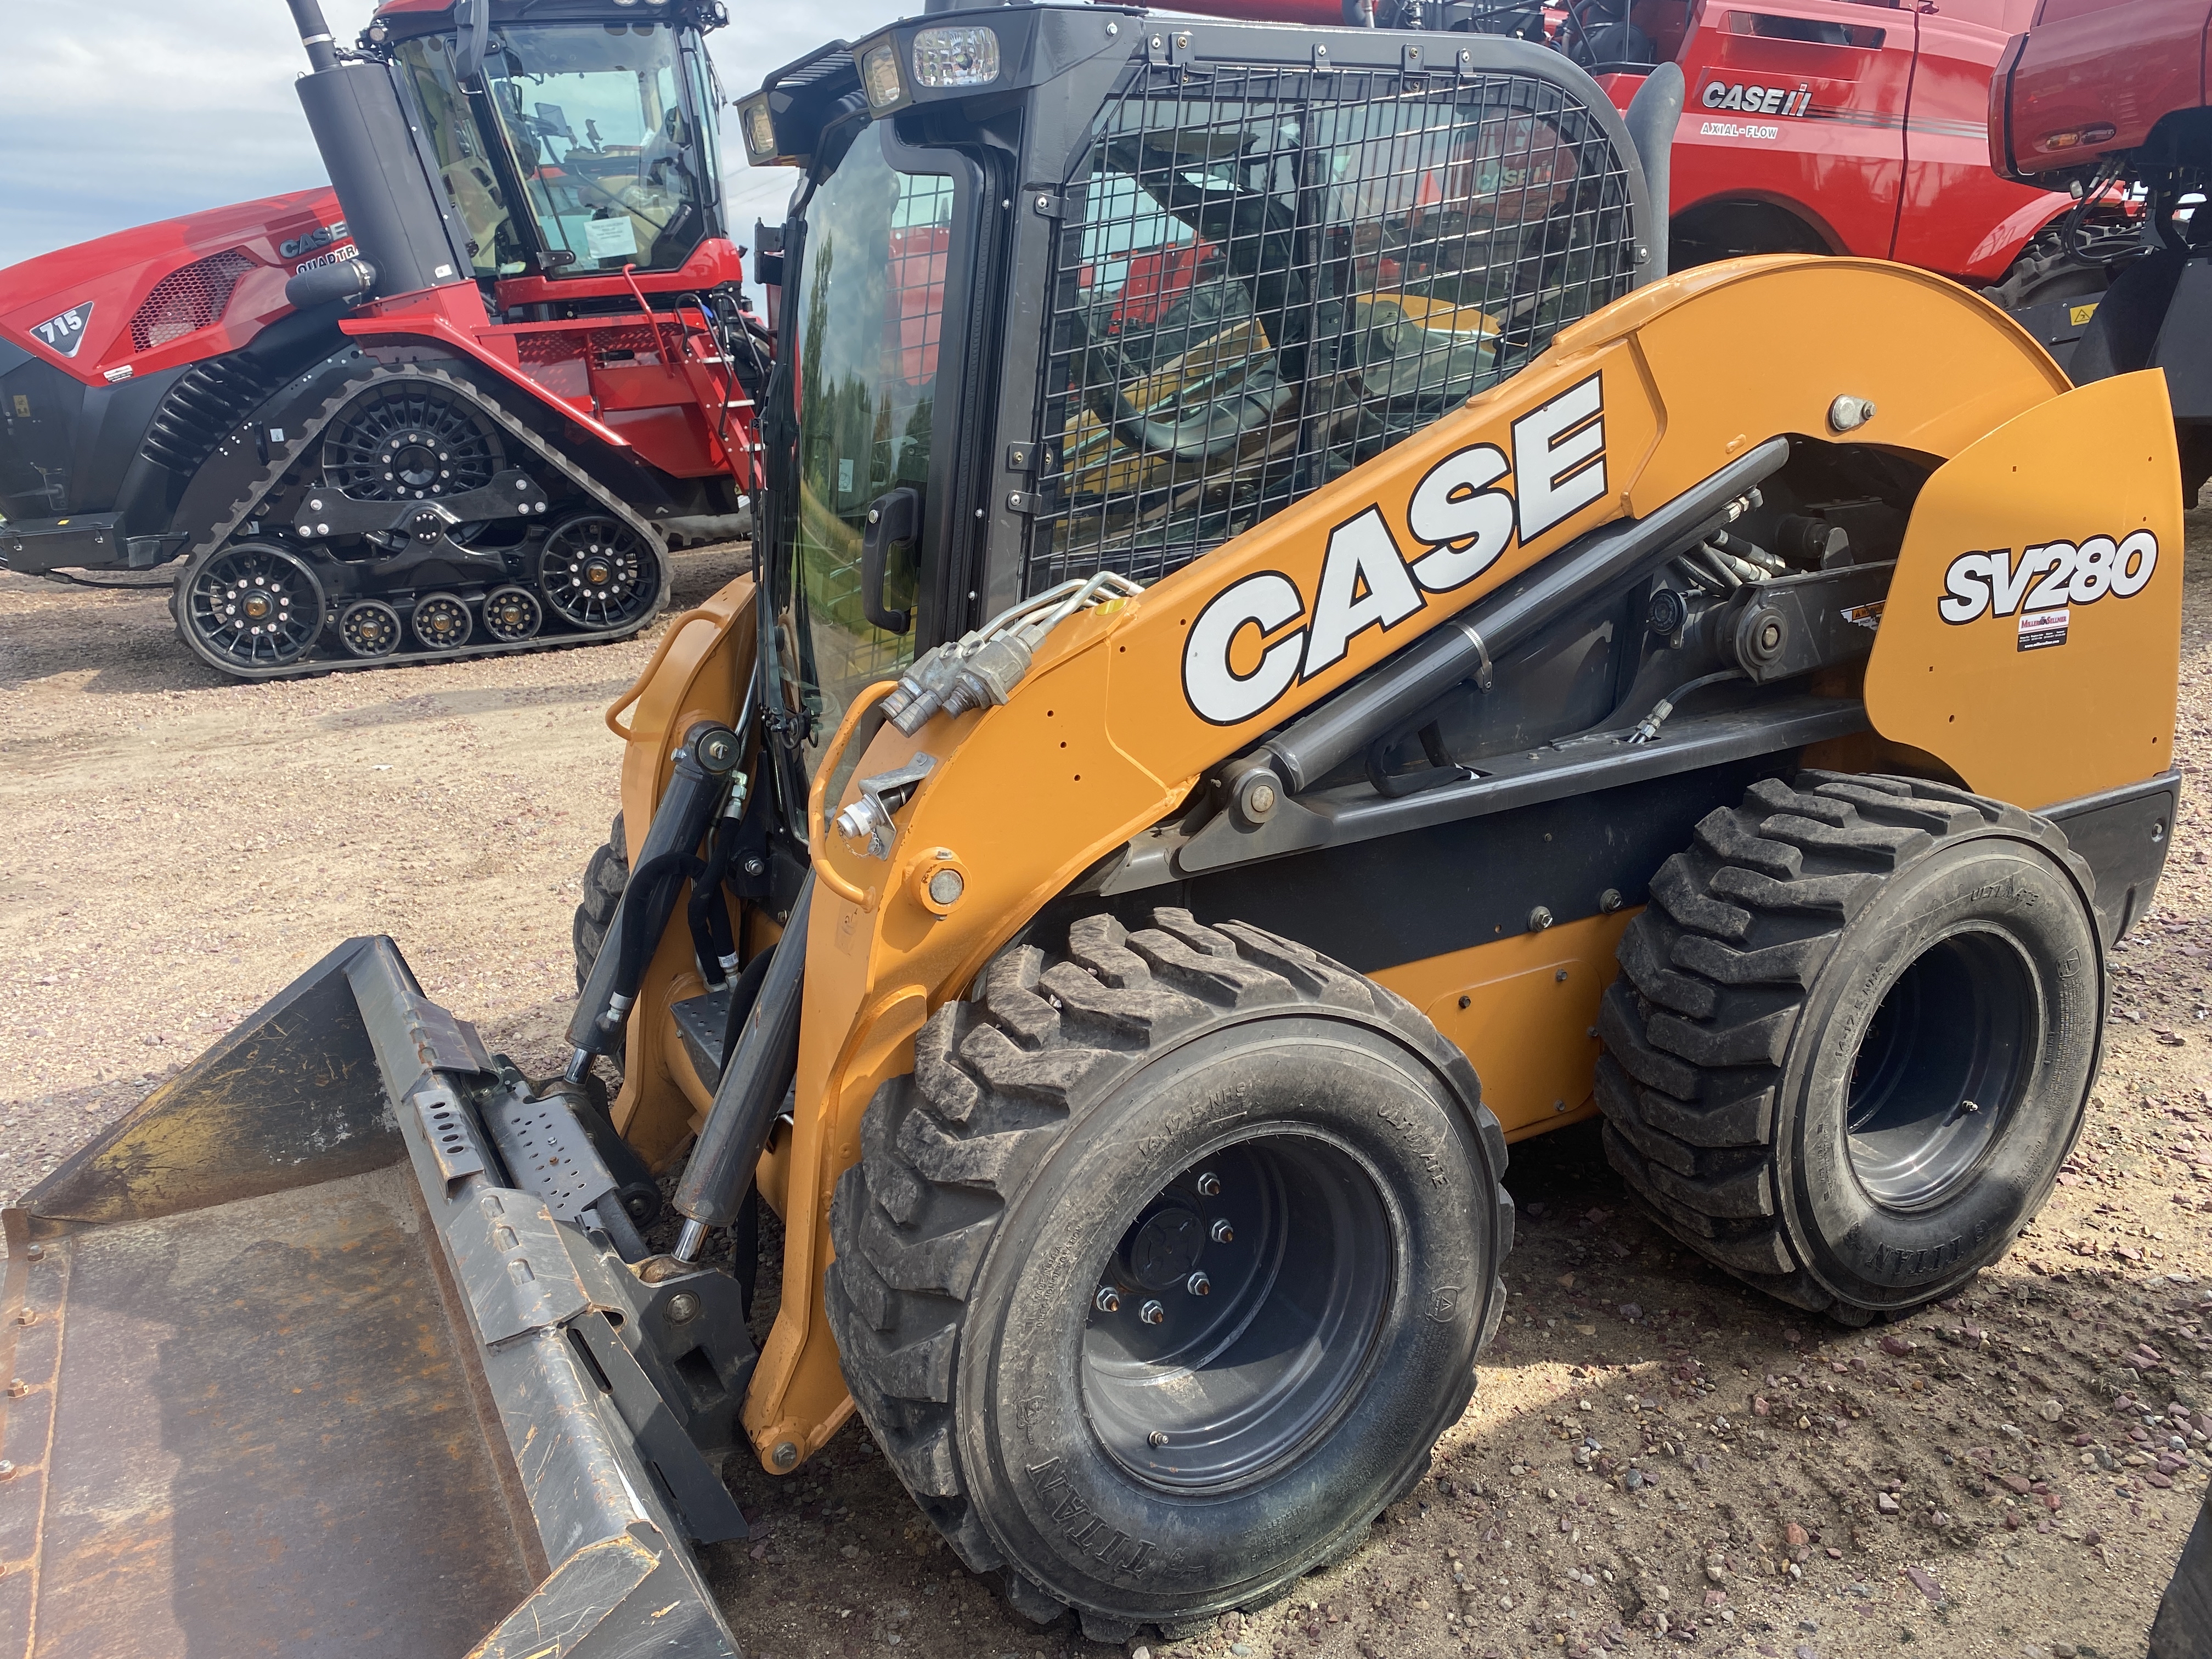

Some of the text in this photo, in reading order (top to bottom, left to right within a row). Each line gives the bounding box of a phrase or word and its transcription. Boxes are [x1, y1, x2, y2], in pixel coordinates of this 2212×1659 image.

[1702, 81, 1785, 114] CASE
[1701, 122, 1778, 139] AXIAL-FLOW
[1476, 167, 1531, 190] CASE
[280, 221, 349, 259] CASE
[296, 244, 360, 274] QUADTR
[40, 309, 82, 343] 715
[1181, 369, 1609, 726] CASE
[1938, 529, 2158, 625] SV280
[1866, 1235, 1963, 1276] TITAN
[1025, 1457, 1159, 1578] TITAN
